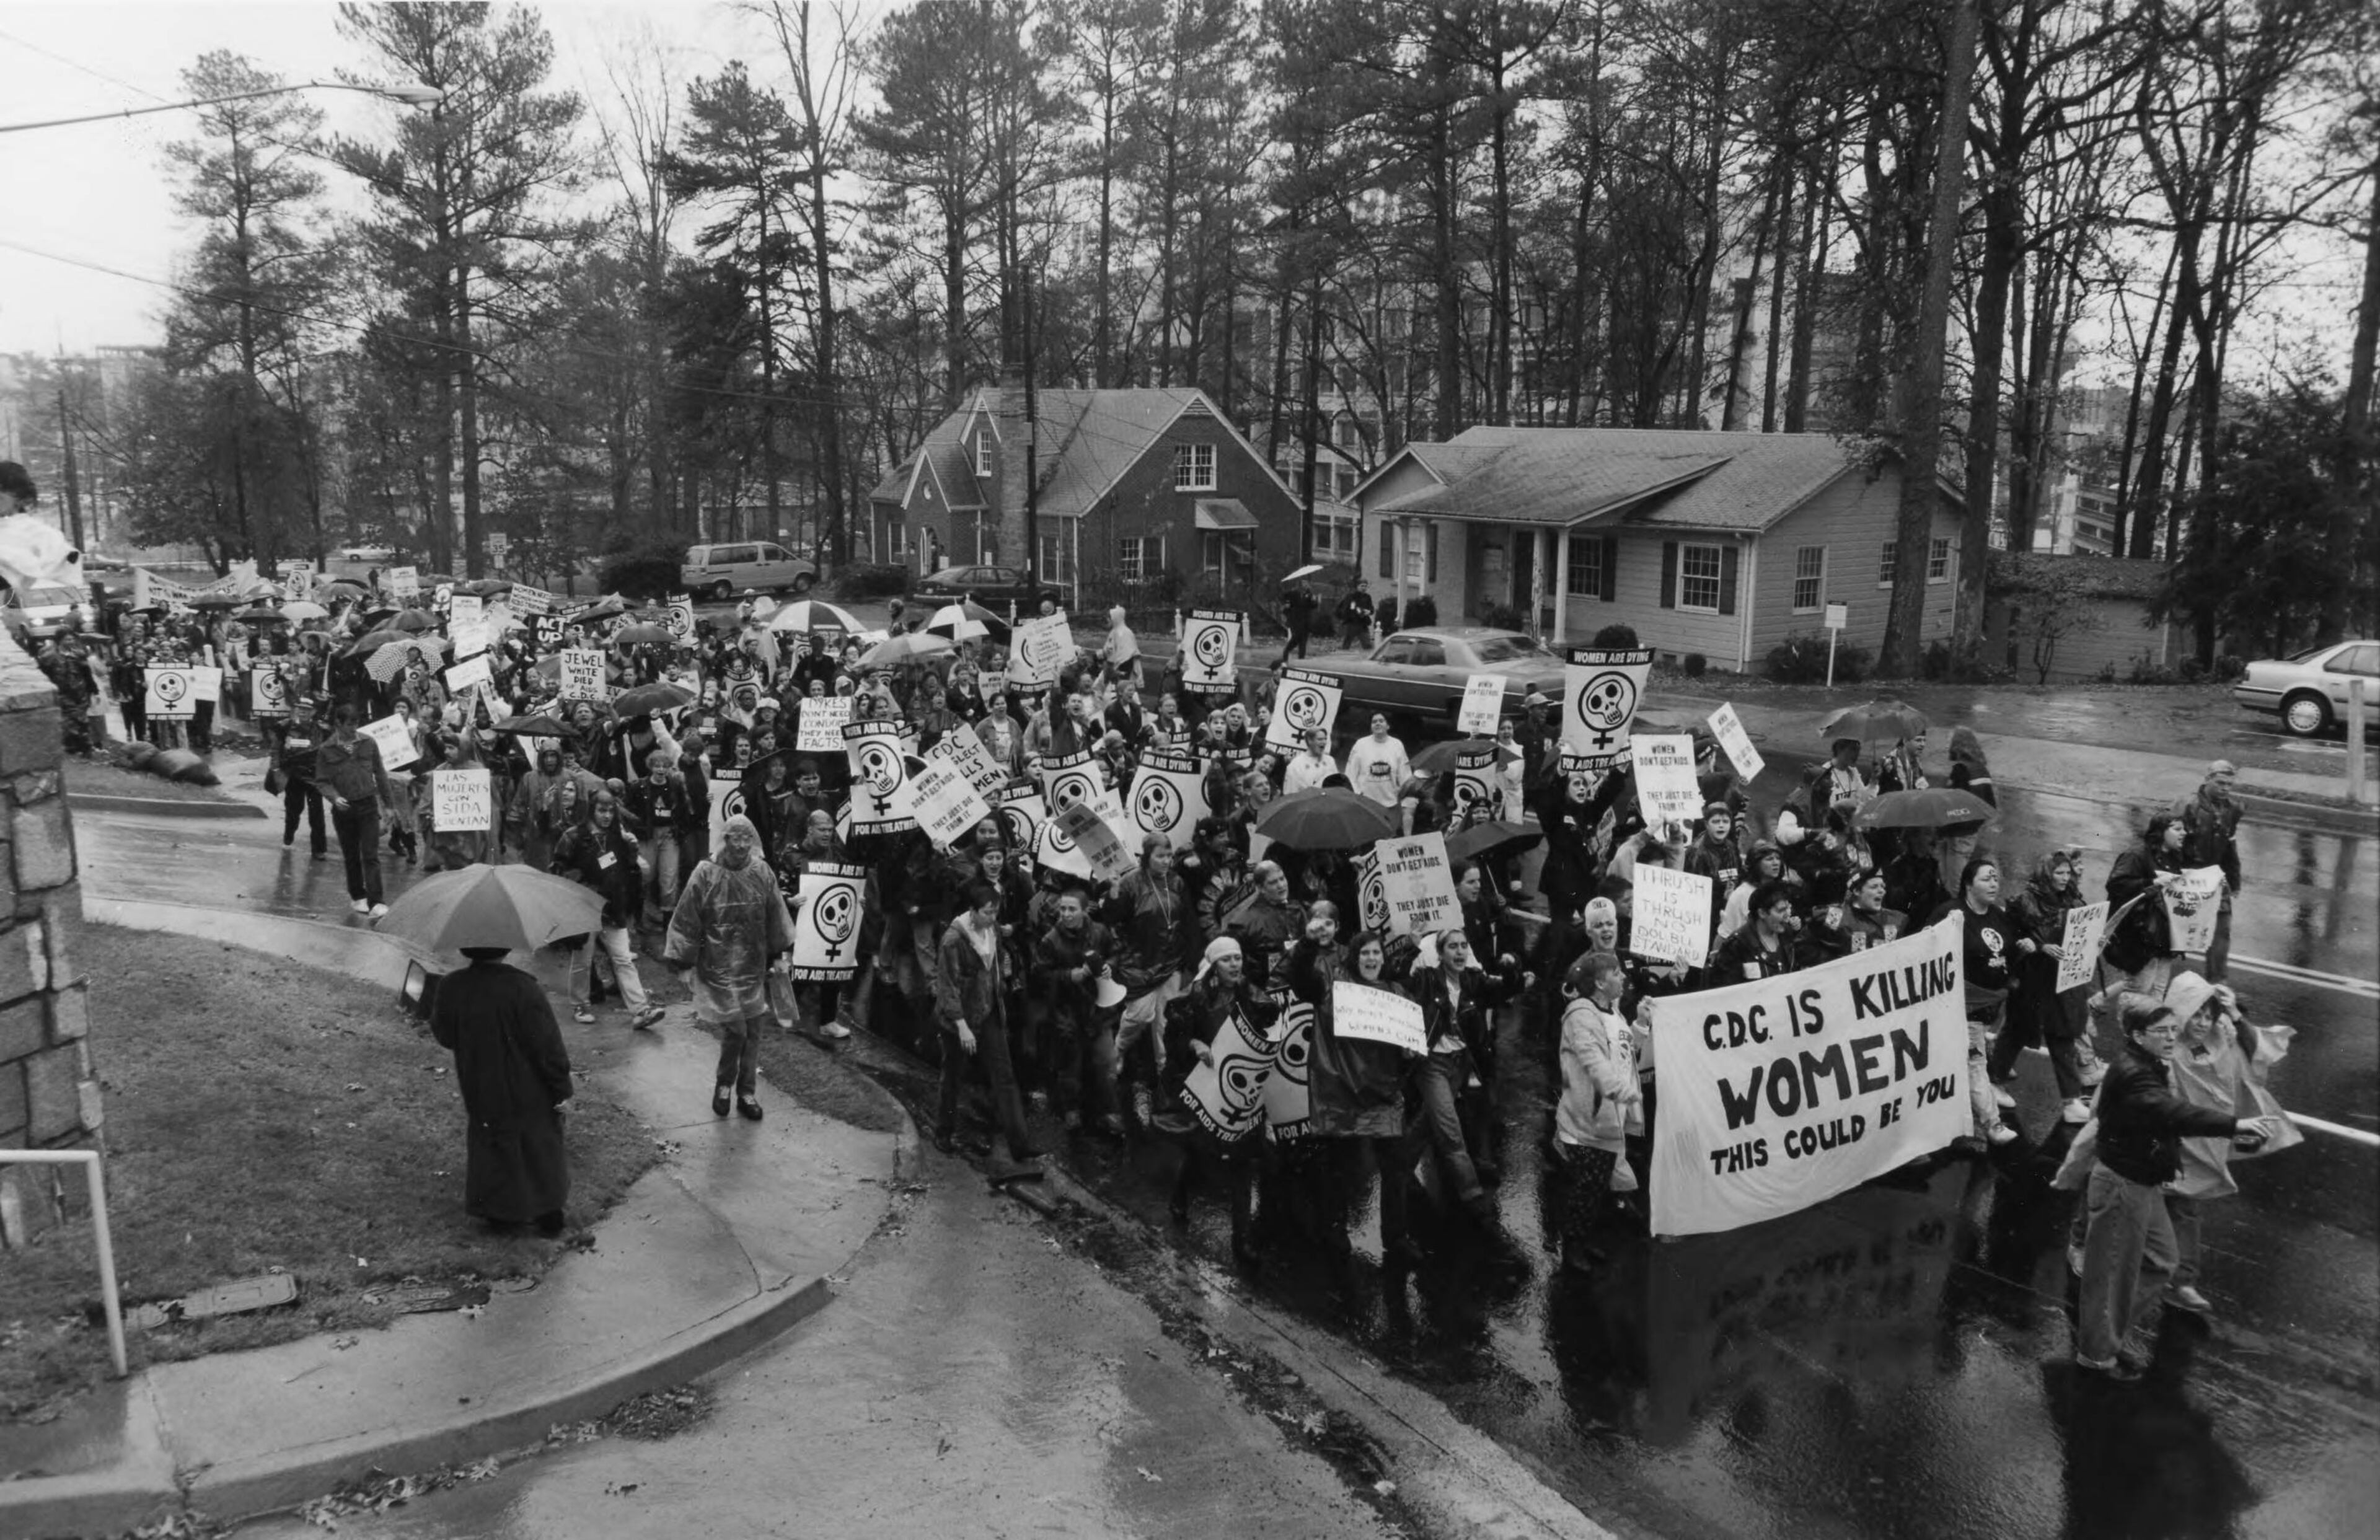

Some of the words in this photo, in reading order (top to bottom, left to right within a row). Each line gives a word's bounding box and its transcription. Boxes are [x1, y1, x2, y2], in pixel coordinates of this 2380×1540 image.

[492, 544, 505, 553] 35
[537, 617, 566, 633] ACT
[537, 630, 563, 643] UP
[565, 653, 604, 667] JEWEL
[1574, 651, 1606, 664] WOMEN
[1608, 651, 1624, 663] ARE
[1626, 651, 1649, 662] DYING
[568, 666, 598, 677] WHITE
[574, 676, 593, 685] DIED
[809, 697, 847, 708] DYKES
[863, 723, 879, 734] ARE
[804, 737, 844, 749] FACTS!
[932, 735, 964, 759] CDC
[1651, 745, 1675, 755] WOMEN
[951, 744, 981, 765] GLECT
[1062, 754, 1077, 767] ARE
[1458, 756, 1472, 767] ARE
[1474, 751, 1493, 767] DYING
[1639, 757, 1659, 766] DON'T
[1660, 757, 1673, 766] GET
[960, 758, 984, 779] LLS
[1155, 757, 1168, 769] ARE
[1169, 760, 1192, 772] DYING
[1562, 759, 1575, 770] FOR
[1576, 758, 1594, 769] AIDS
[716, 769, 742, 779] WOMEN
[973, 769, 1002, 793] MEN
[917, 772, 939, 792] WOMEN
[928, 781, 941, 796] GET
[1012, 785, 1034, 798] DYING
[1646, 791, 1664, 800] THEY
[1665, 791, 1680, 800] JUST
[1681, 791, 1693, 799] DIE
[442, 801, 481, 815] SIDA
[932, 816, 949, 830] THEY
[948, 804, 963, 820] JUST
[961, 796, 974, 807] DIE
[855, 824, 870, 835] FOR
[946, 816, 964, 832] FROM
[1397, 845, 1424, 859] WOMEN
[808, 862, 839, 874] WOMEN
[840, 865, 855, 876] ARE
[1386, 861, 1407, 874] DON'T
[1408, 859, 1422, 871] GET
[1642, 868, 1705, 895] THRUSH
[1396, 900, 1414, 912] THEY
[1417, 897, 1432, 909] JUST
[1436, 895, 1449, 906] DIE
[1664, 891, 1678, 905] IS
[1642, 899, 1702, 926] THRUSH
[2069, 906, 2104, 925] WOMEN
[1633, 935, 1700, 961] STANDARD
[794, 969, 808, 980] FOR
[808, 969, 826, 980] AIDS
[1703, 1004, 1773, 1051] C.D.C.
[1786, 989, 1824, 1037] IS
[1849, 951, 1956, 1021] KILLING
[1236, 1014, 1269, 1053] WOMEN
[1717, 1018, 1929, 1130] WOMEN
[1179, 1088, 1200, 1110] FOR
[1196, 1108, 1217, 1132] AIDS
[1709, 1138, 1768, 1176] THIS
[1784, 1114, 1866, 1159] COULD
[1879, 1098, 1902, 1129] BE
[1916, 1073, 1955, 1109] YOU
[1277, 1125, 1298, 1139] FOR
